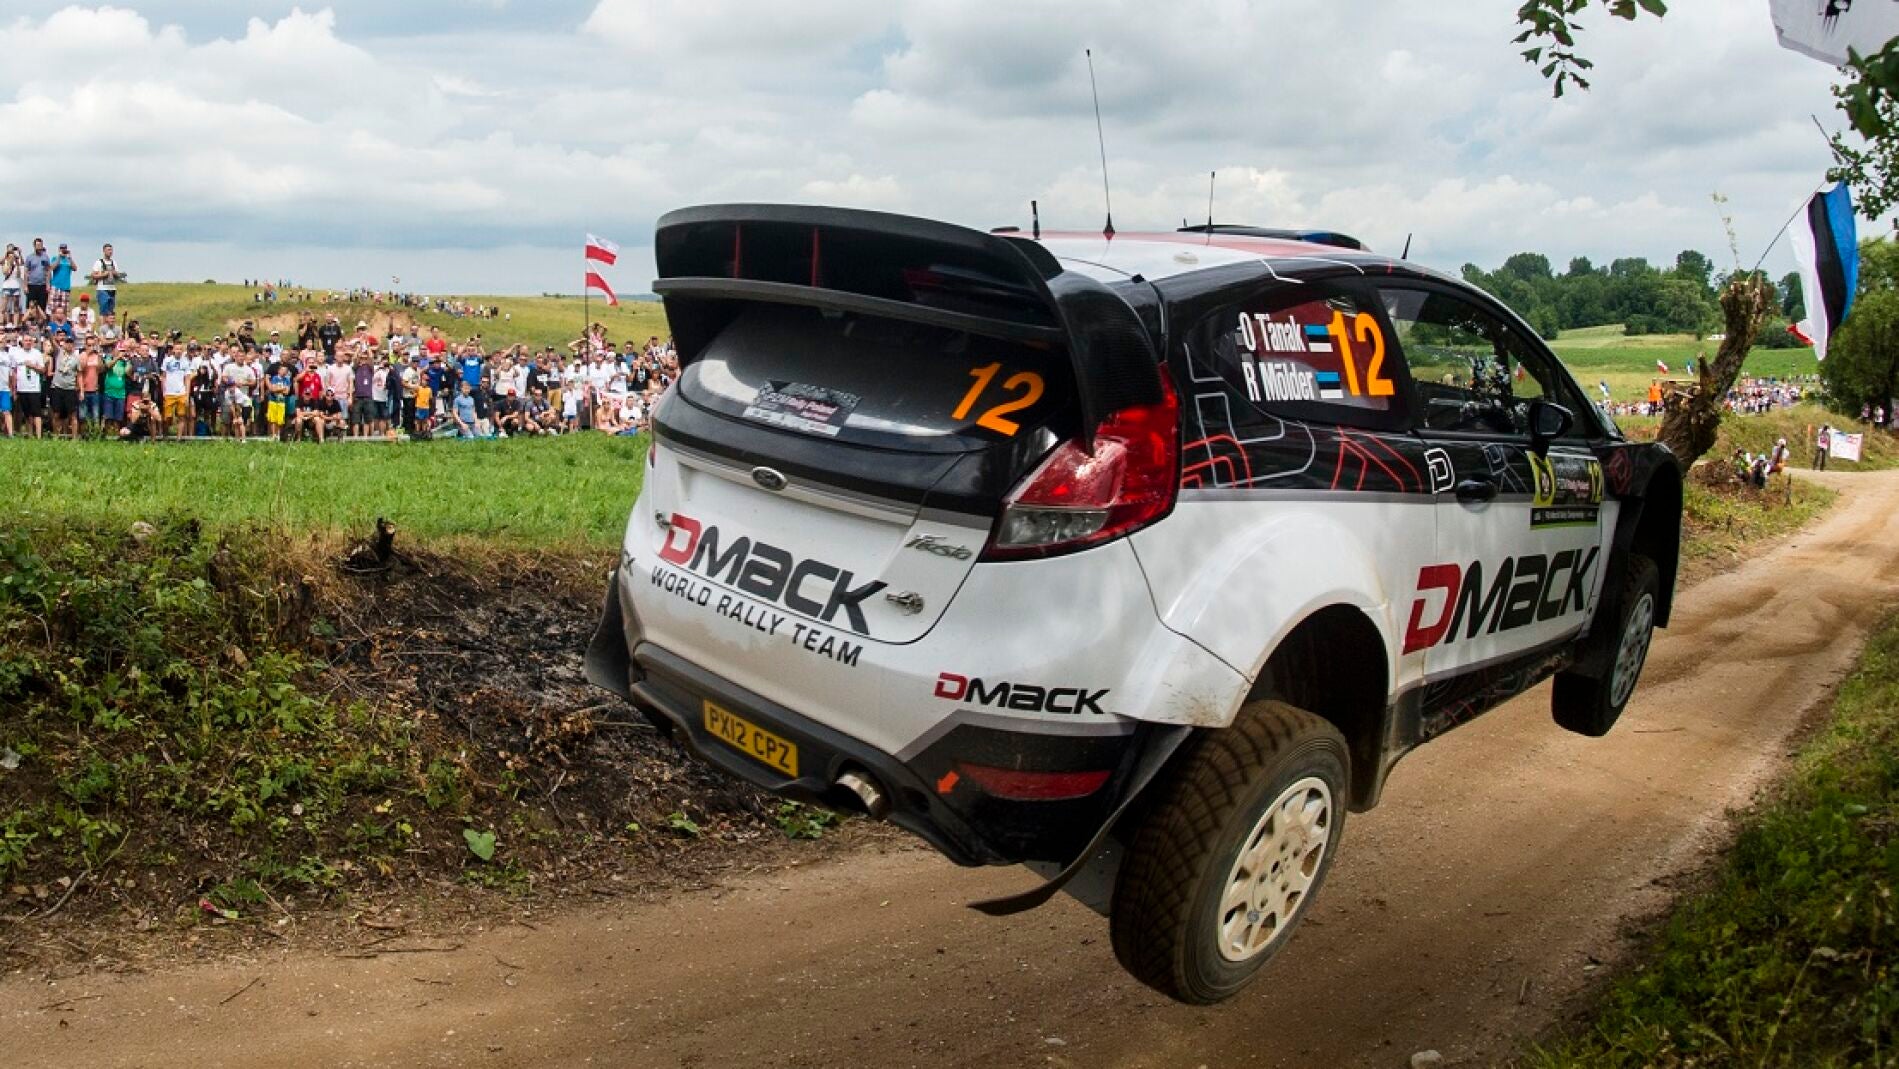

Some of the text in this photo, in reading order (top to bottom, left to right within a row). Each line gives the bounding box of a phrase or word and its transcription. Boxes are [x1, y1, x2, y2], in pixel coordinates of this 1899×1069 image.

[1239, 312, 1256, 351] O
[1327, 310, 1395, 396] 12
[951, 361, 1044, 436] 12
[1241, 361, 1261, 402] R
[651, 565, 863, 667] WORLD RALLY TEAM
